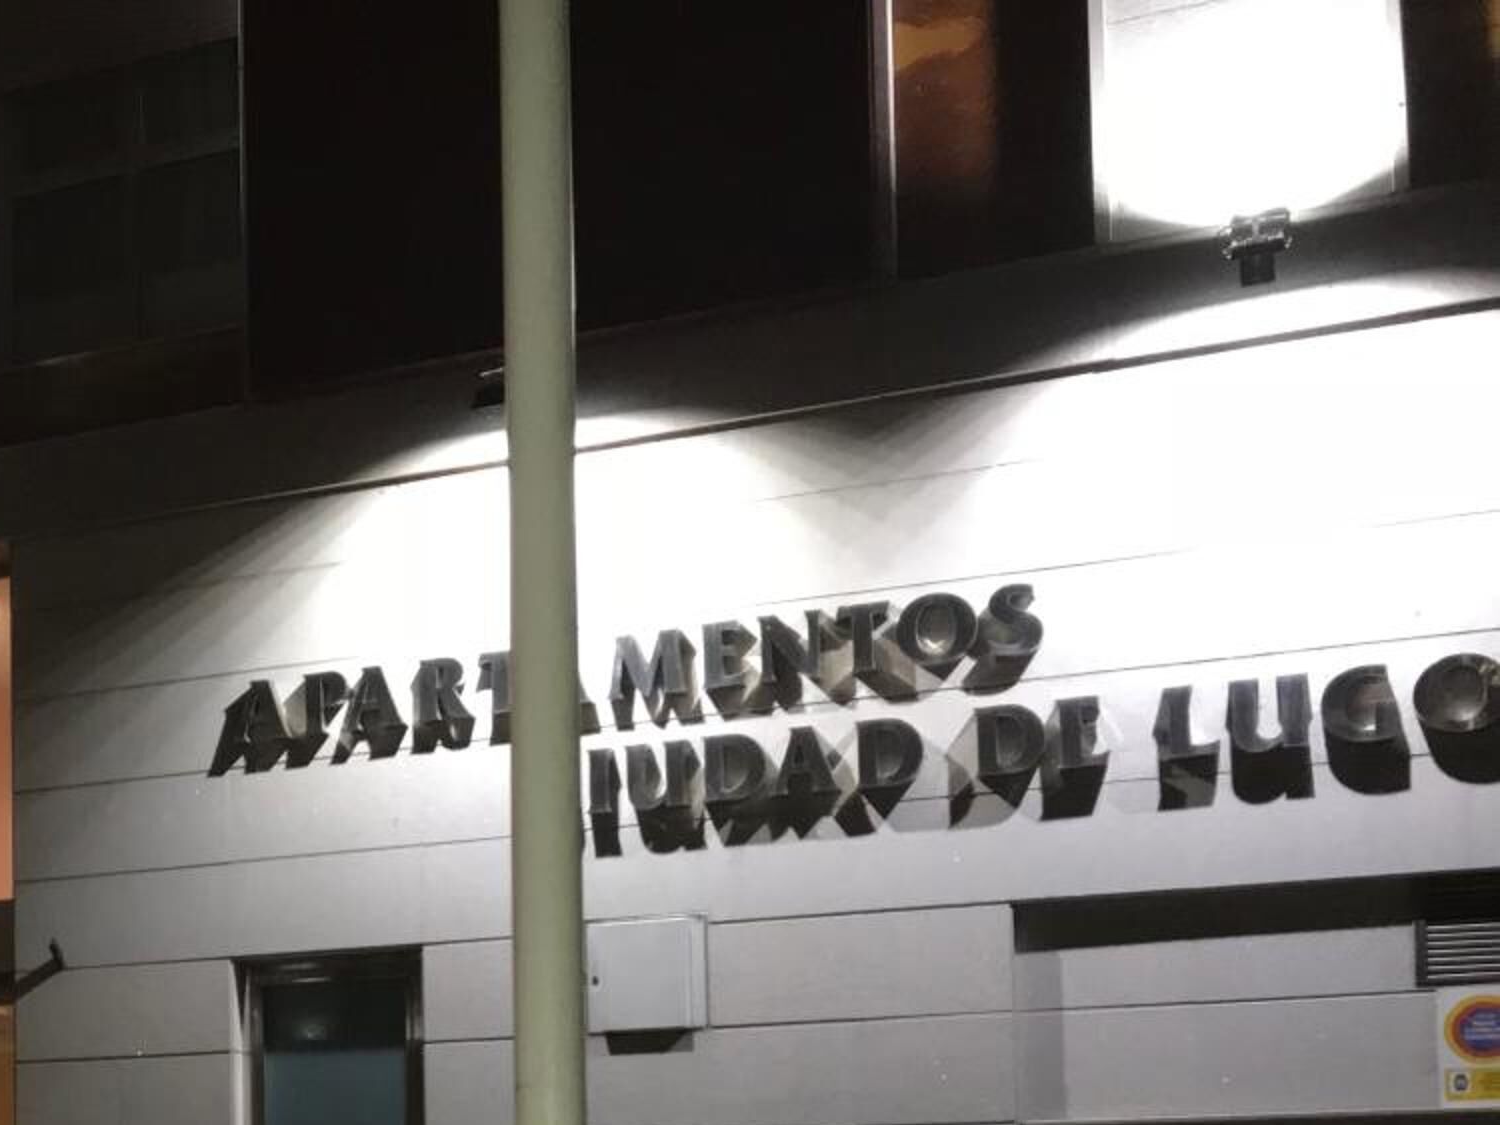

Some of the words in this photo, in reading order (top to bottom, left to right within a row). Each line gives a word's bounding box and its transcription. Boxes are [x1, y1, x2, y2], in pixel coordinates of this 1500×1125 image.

[215, 583, 1043, 757] APARTMENTOS
[586, 717, 924, 838] IUDAD
[970, 694, 1110, 800] DE
[1155, 653, 1500, 785] LUGO
